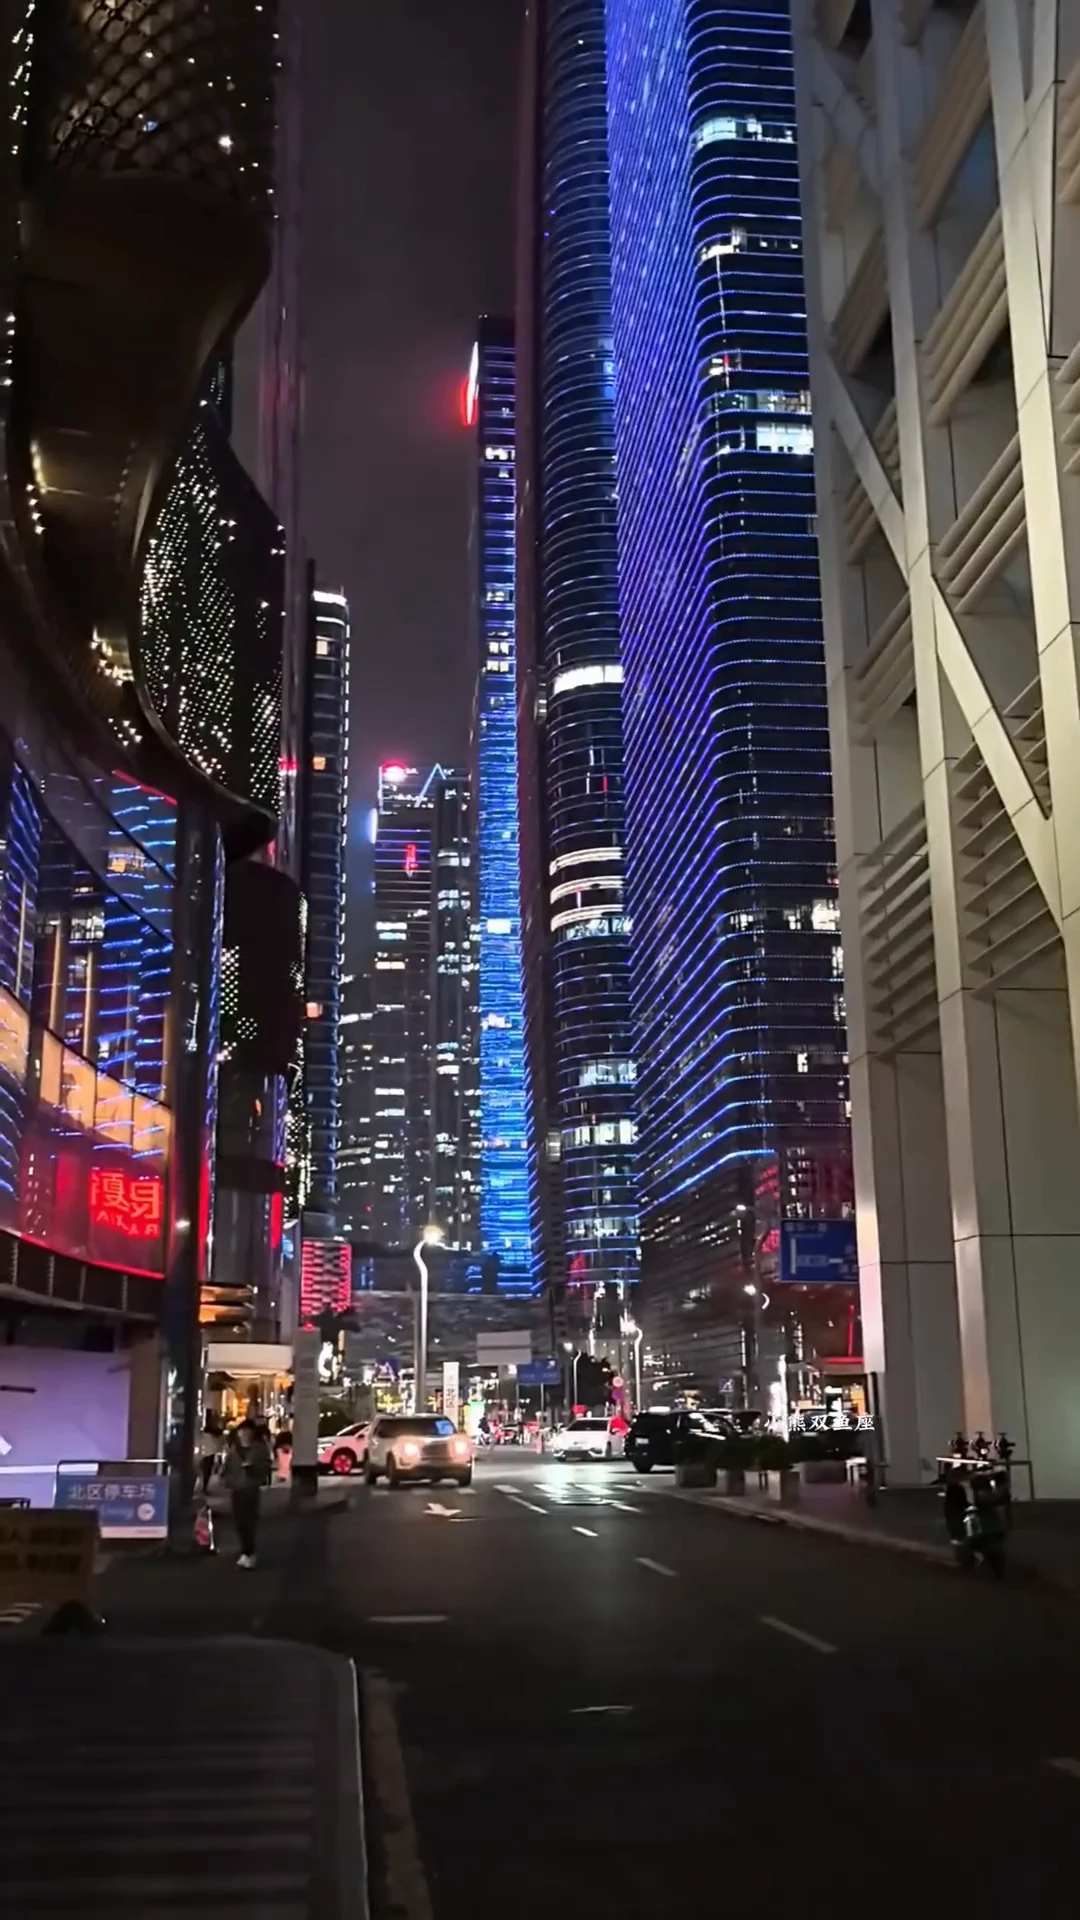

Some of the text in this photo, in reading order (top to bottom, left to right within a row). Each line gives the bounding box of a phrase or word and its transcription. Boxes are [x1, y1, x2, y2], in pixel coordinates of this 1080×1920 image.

[68, 1483, 156, 1501] 北区停车场
